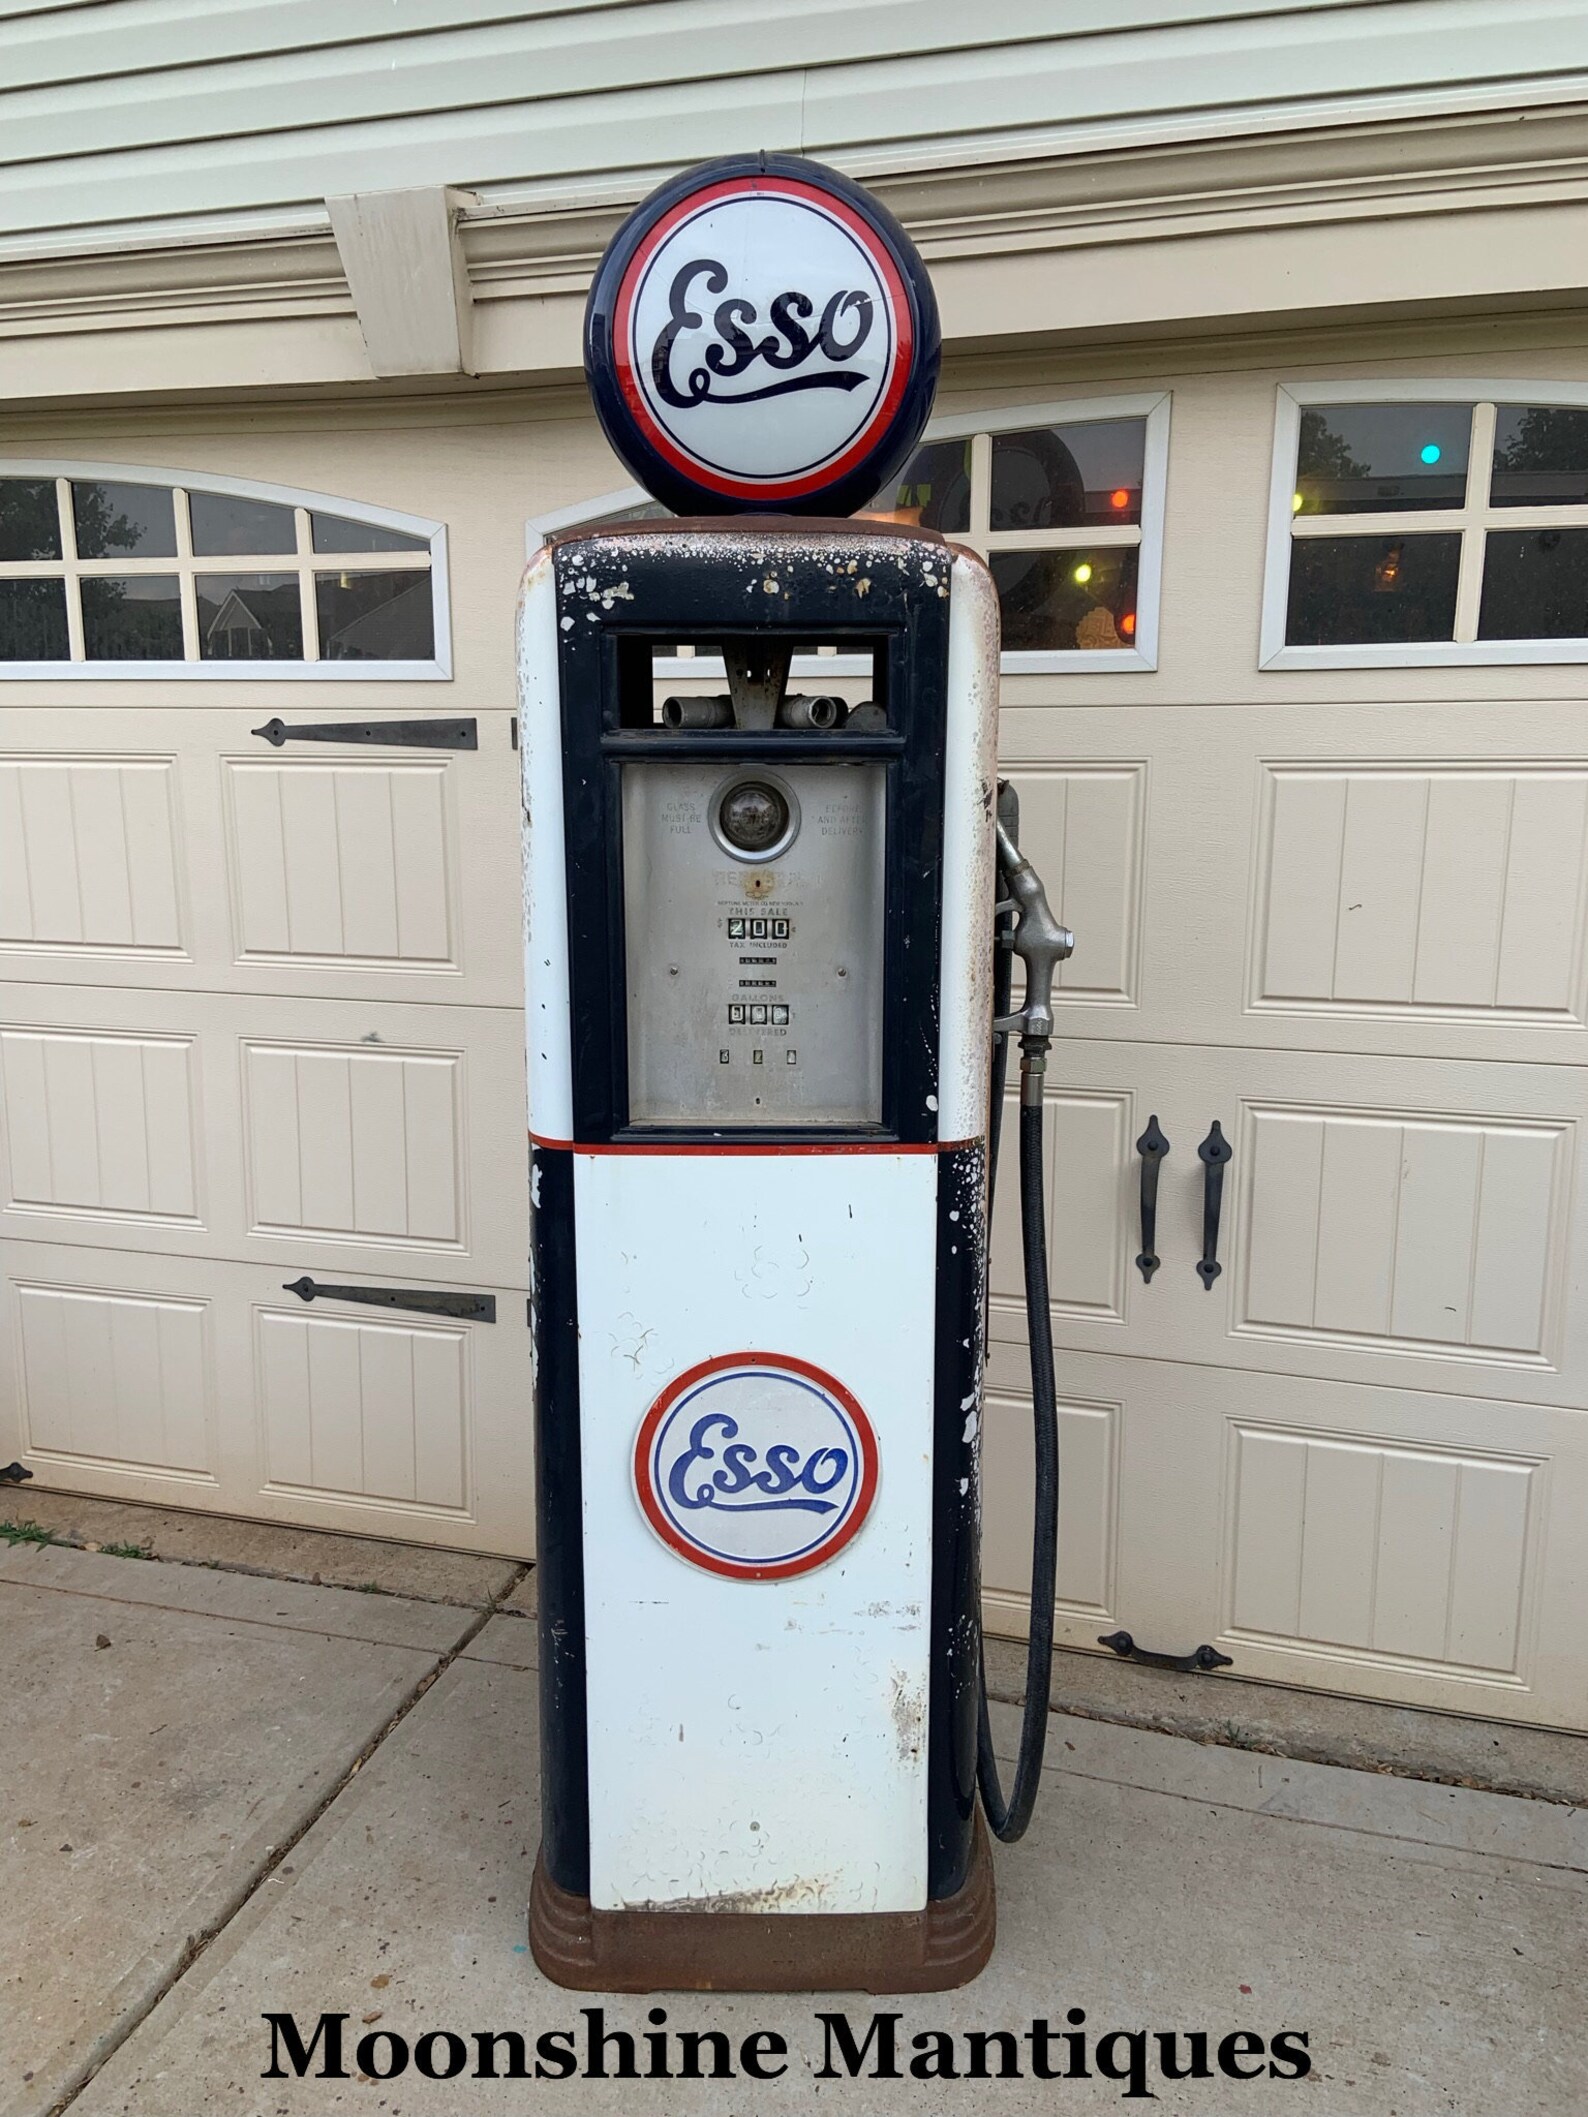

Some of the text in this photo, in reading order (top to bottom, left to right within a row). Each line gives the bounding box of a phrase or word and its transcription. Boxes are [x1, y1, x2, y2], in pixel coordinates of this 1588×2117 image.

[652, 259, 874, 408] Esso
[670, 825, 692, 834] FULL
[729, 907, 788, 916] THIS SALE
[668, 1413, 848, 1514] Esso
